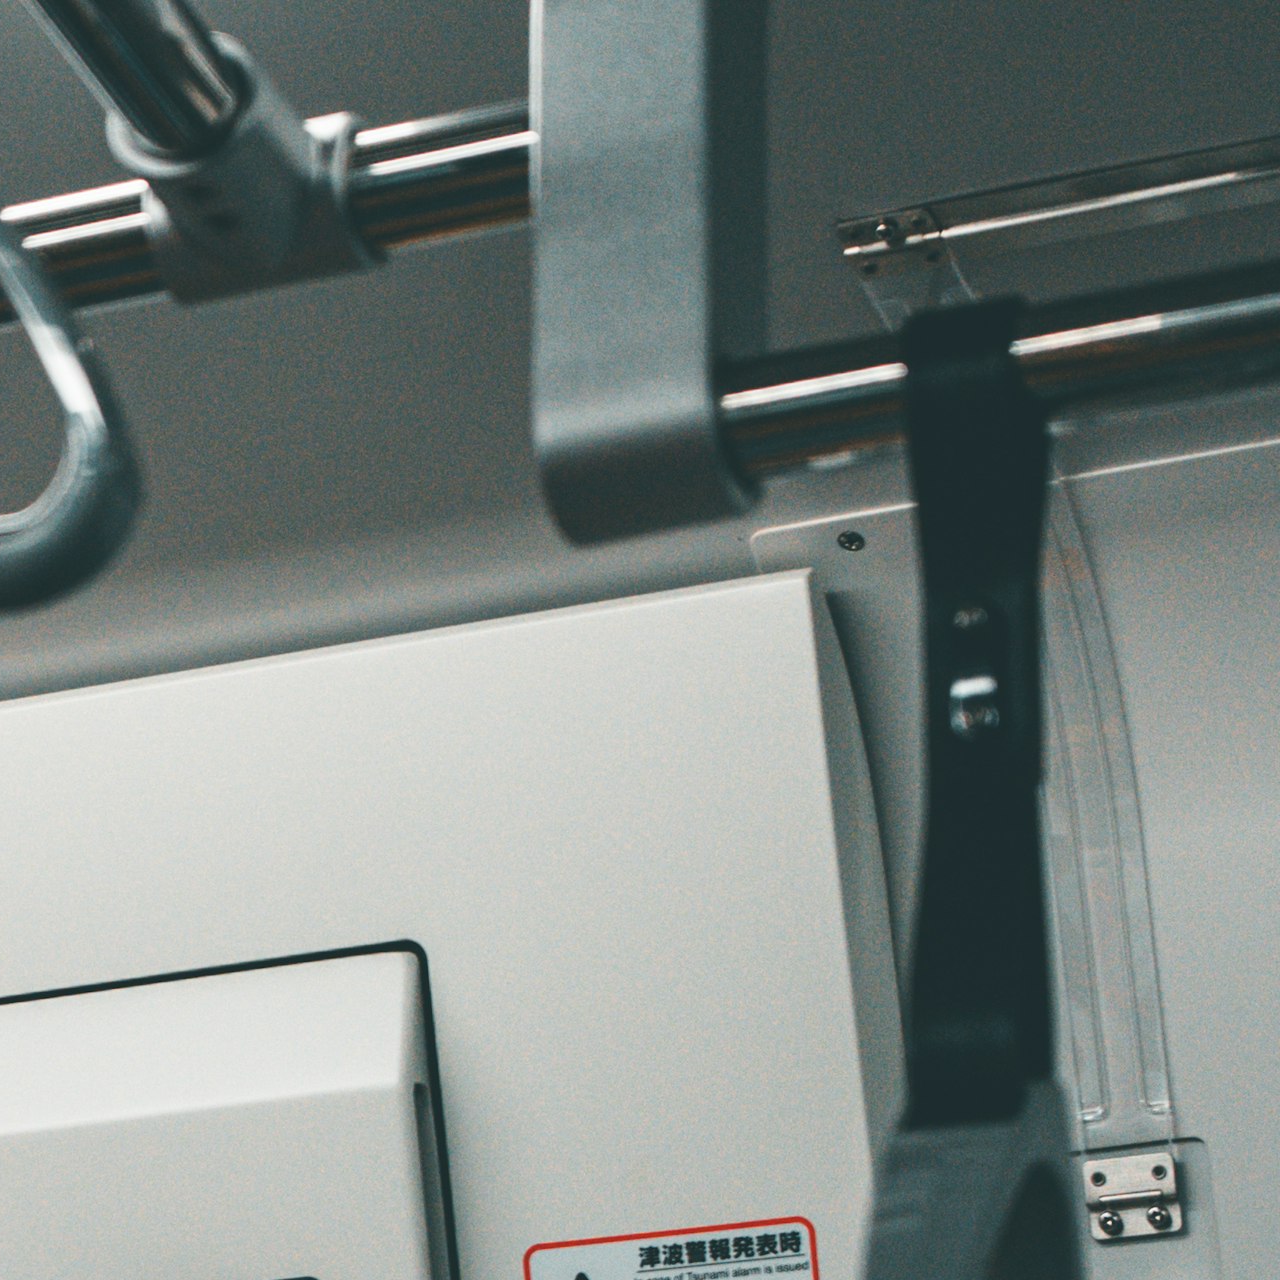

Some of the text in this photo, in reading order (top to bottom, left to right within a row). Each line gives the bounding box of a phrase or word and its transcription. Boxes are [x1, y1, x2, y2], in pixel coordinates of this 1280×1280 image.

[638, 1230, 803, 1269] 津波警報発表時
[732, 1267, 761, 1278] alarm
[763, 1265, 772, 1275] is
[775, 1261, 810, 1273] issued
